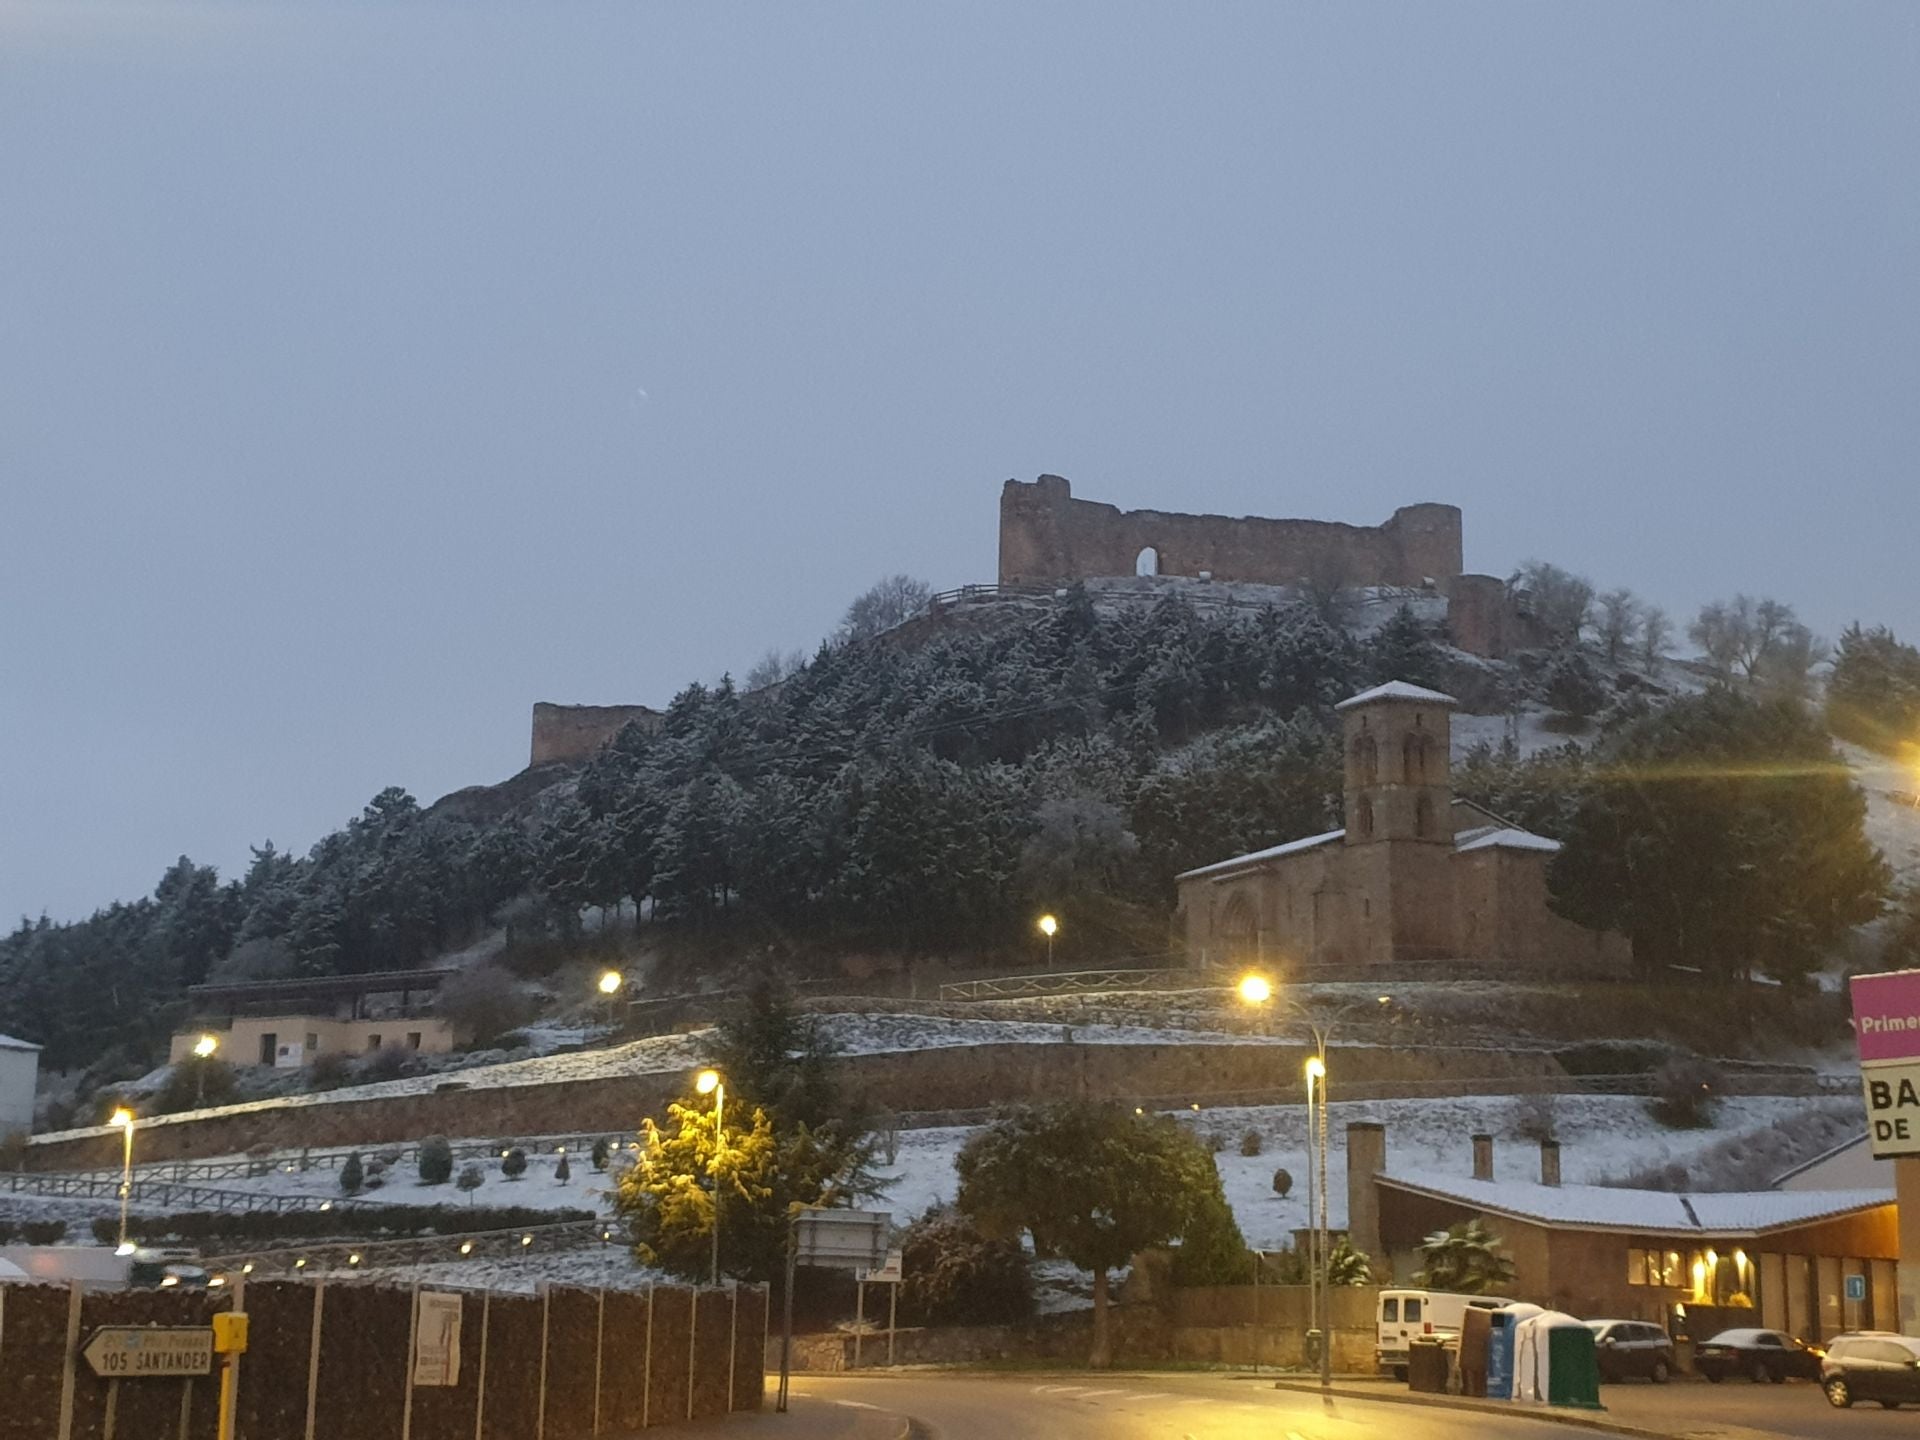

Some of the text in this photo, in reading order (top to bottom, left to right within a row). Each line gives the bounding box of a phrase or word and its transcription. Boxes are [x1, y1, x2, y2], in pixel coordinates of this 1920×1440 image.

[1861, 1014, 1920, 1034] Prime
[1869, 1078, 1920, 1110] BA
[1874, 1118, 1911, 1141] DE
[102, 1351, 208, 1371] 105 SANTANDER
